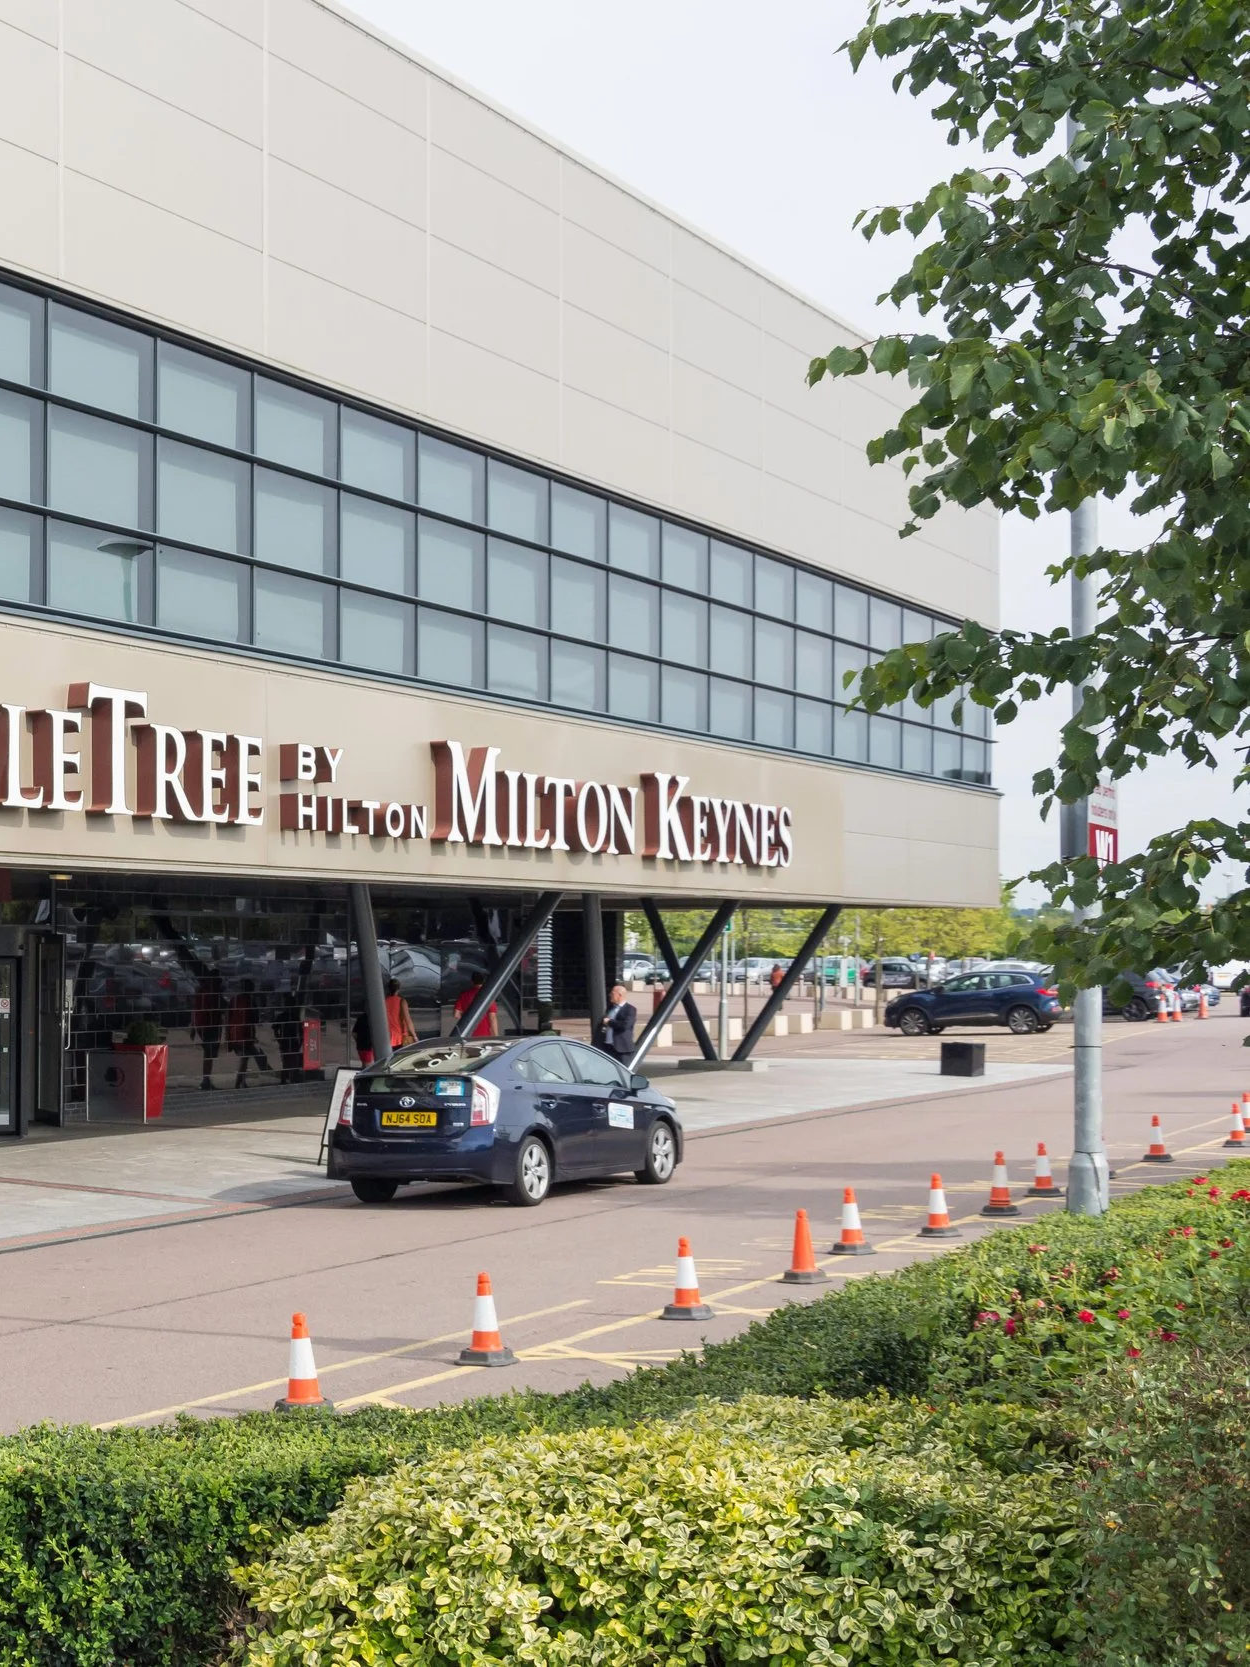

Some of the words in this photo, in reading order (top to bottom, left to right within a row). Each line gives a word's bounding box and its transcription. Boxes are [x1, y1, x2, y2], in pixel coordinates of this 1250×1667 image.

[298, 743, 344, 783] BY
[298, 793, 427, 839] HILTON
[446, 740, 639, 855] MILTON
[654, 771, 793, 868] KEYNES
[386, 1112, 411, 1124] NJ64
